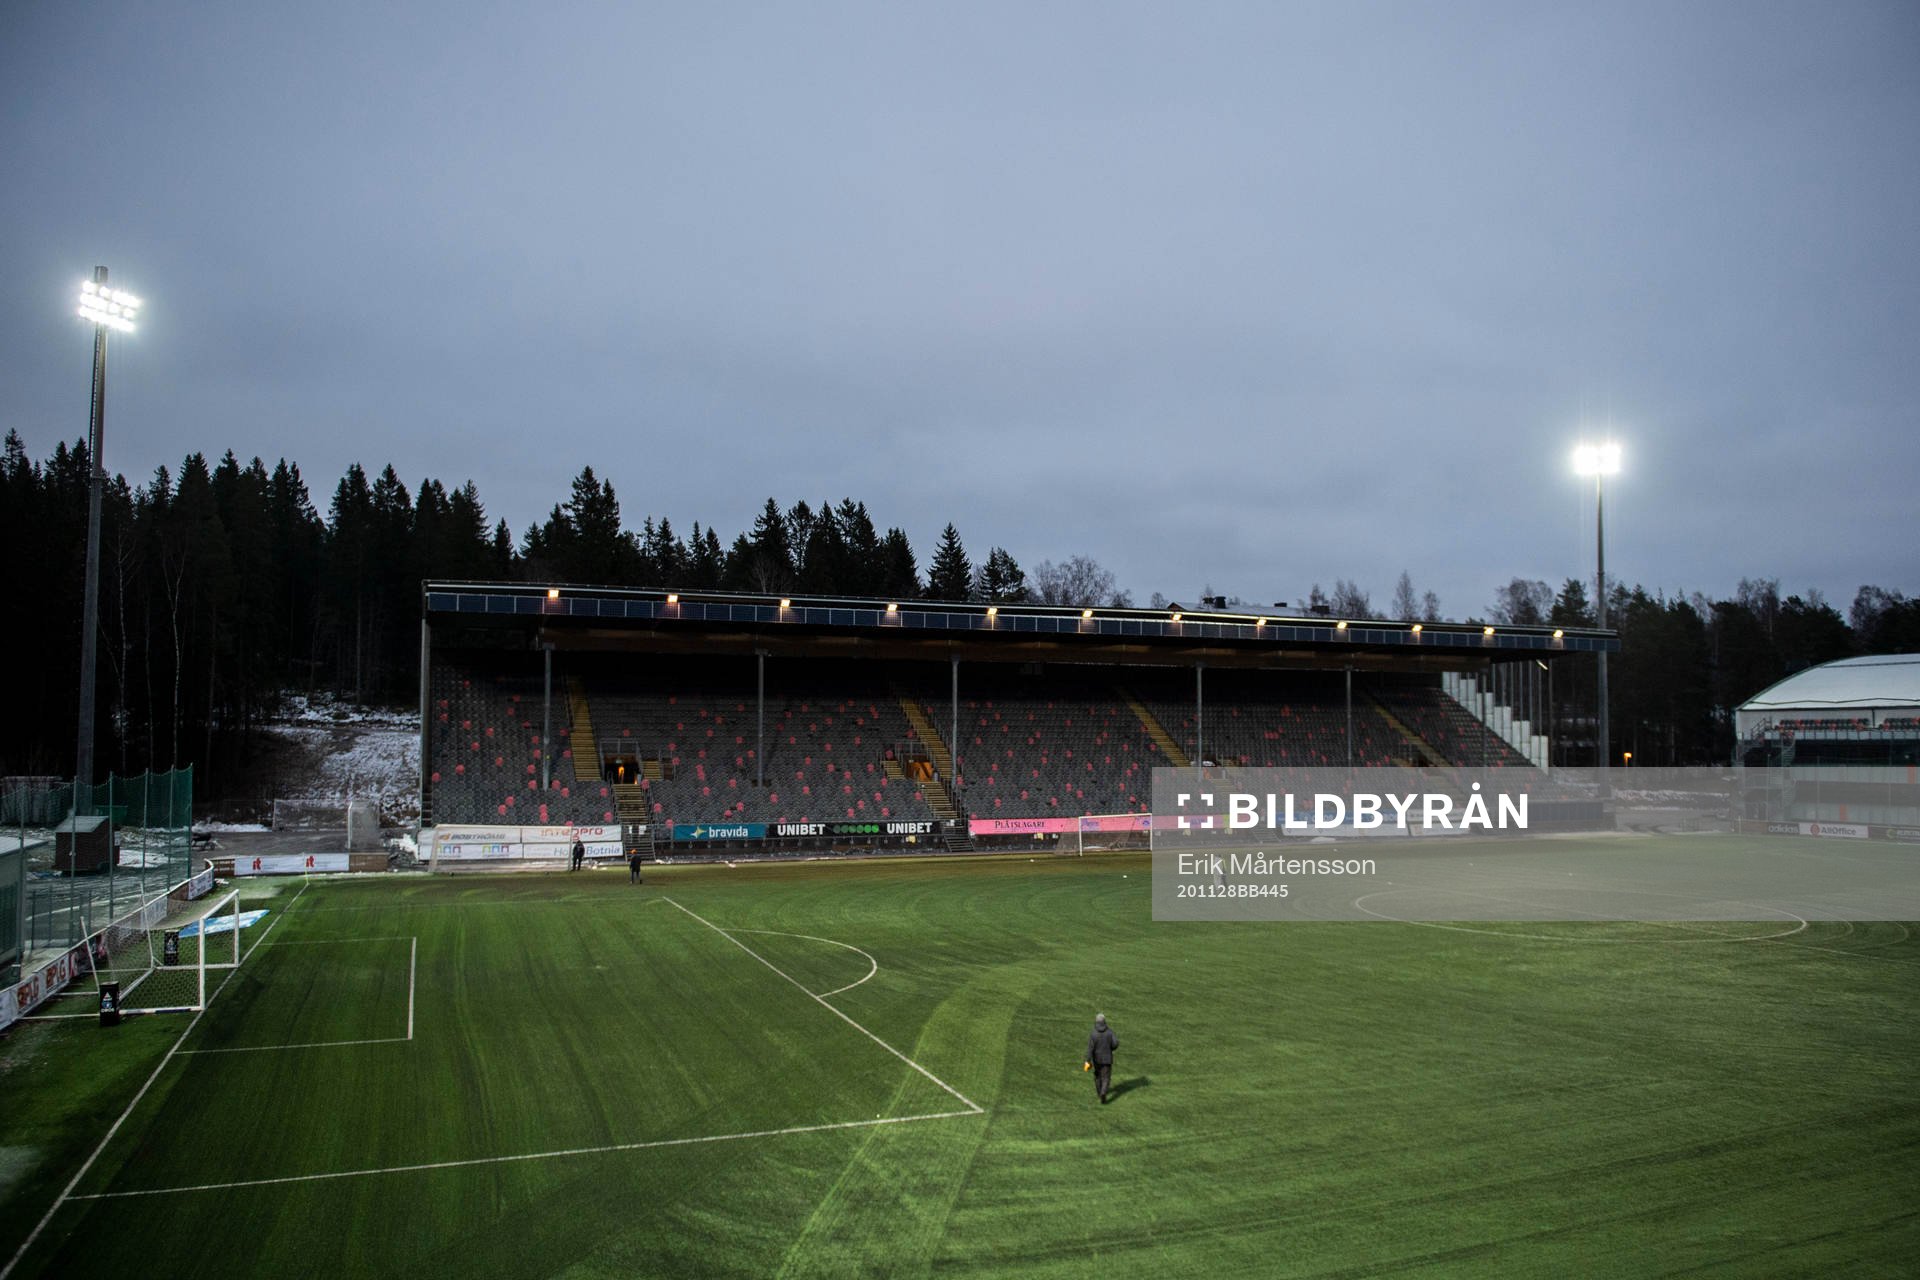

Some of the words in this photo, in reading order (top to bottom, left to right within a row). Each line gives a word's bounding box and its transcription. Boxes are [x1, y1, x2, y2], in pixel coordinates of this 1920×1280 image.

[708, 825, 748, 838] bravida
[777, 823, 826, 836] UNIBET
[887, 822, 933, 834] UNIBET
[1821, 825, 1857, 836] AllOffice
